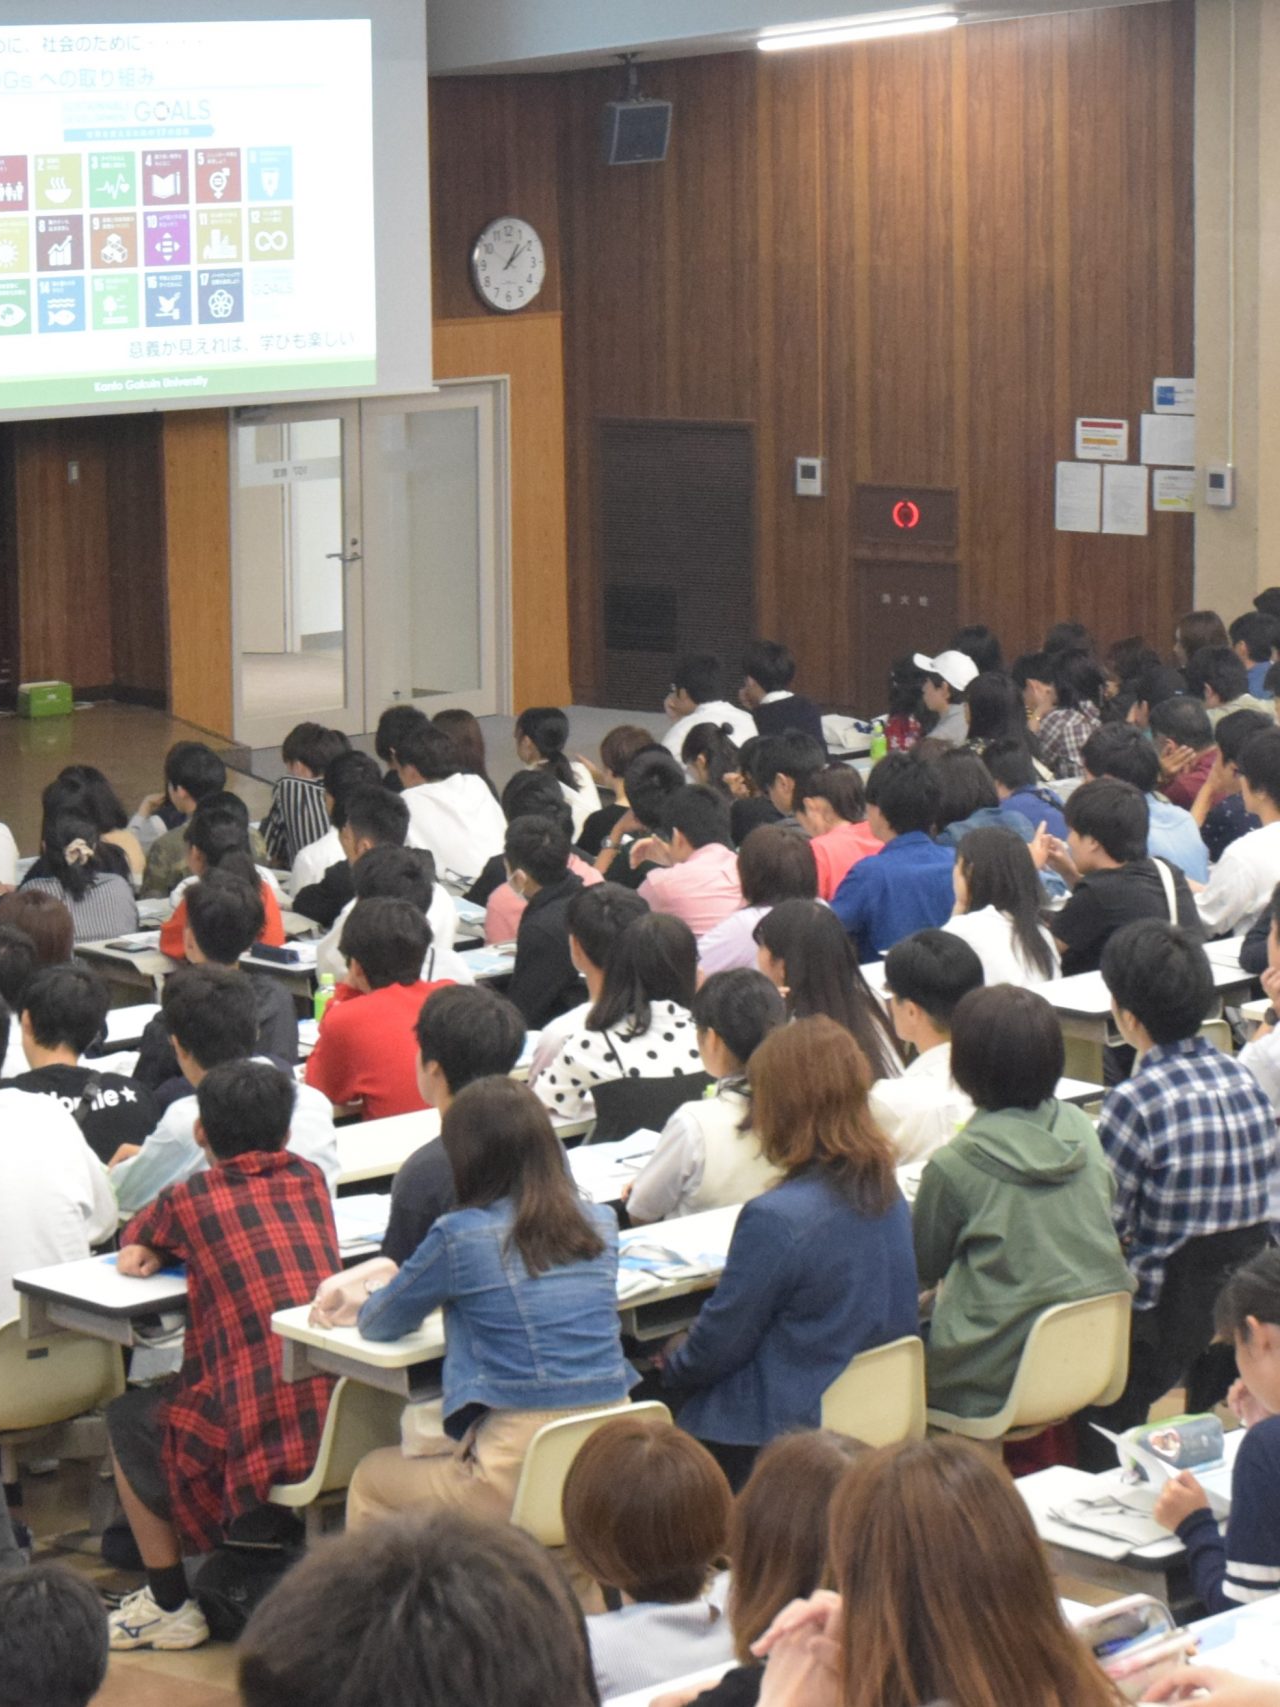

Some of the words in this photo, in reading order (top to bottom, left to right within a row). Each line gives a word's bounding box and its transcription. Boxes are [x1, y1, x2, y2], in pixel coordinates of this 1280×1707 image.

[135, 99, 211, 122] GOALS
[145, 154, 152, 167] 4
[197, 152, 205, 165] 5
[38, 219, 46, 233] 8
[92, 217, 100, 230] 9
[146, 215, 158, 228] 10
[493, 230, 500, 241] 11
[503, 225, 513, 237] 12
[483, 243, 494, 254] 10
[481, 259, 487, 271] 9
[531, 257, 537, 269] 3
[526, 273, 533, 283] 4
[494, 287, 500, 298] 7
[506, 291, 512, 303] 6
[518, 286, 524, 298] 5
